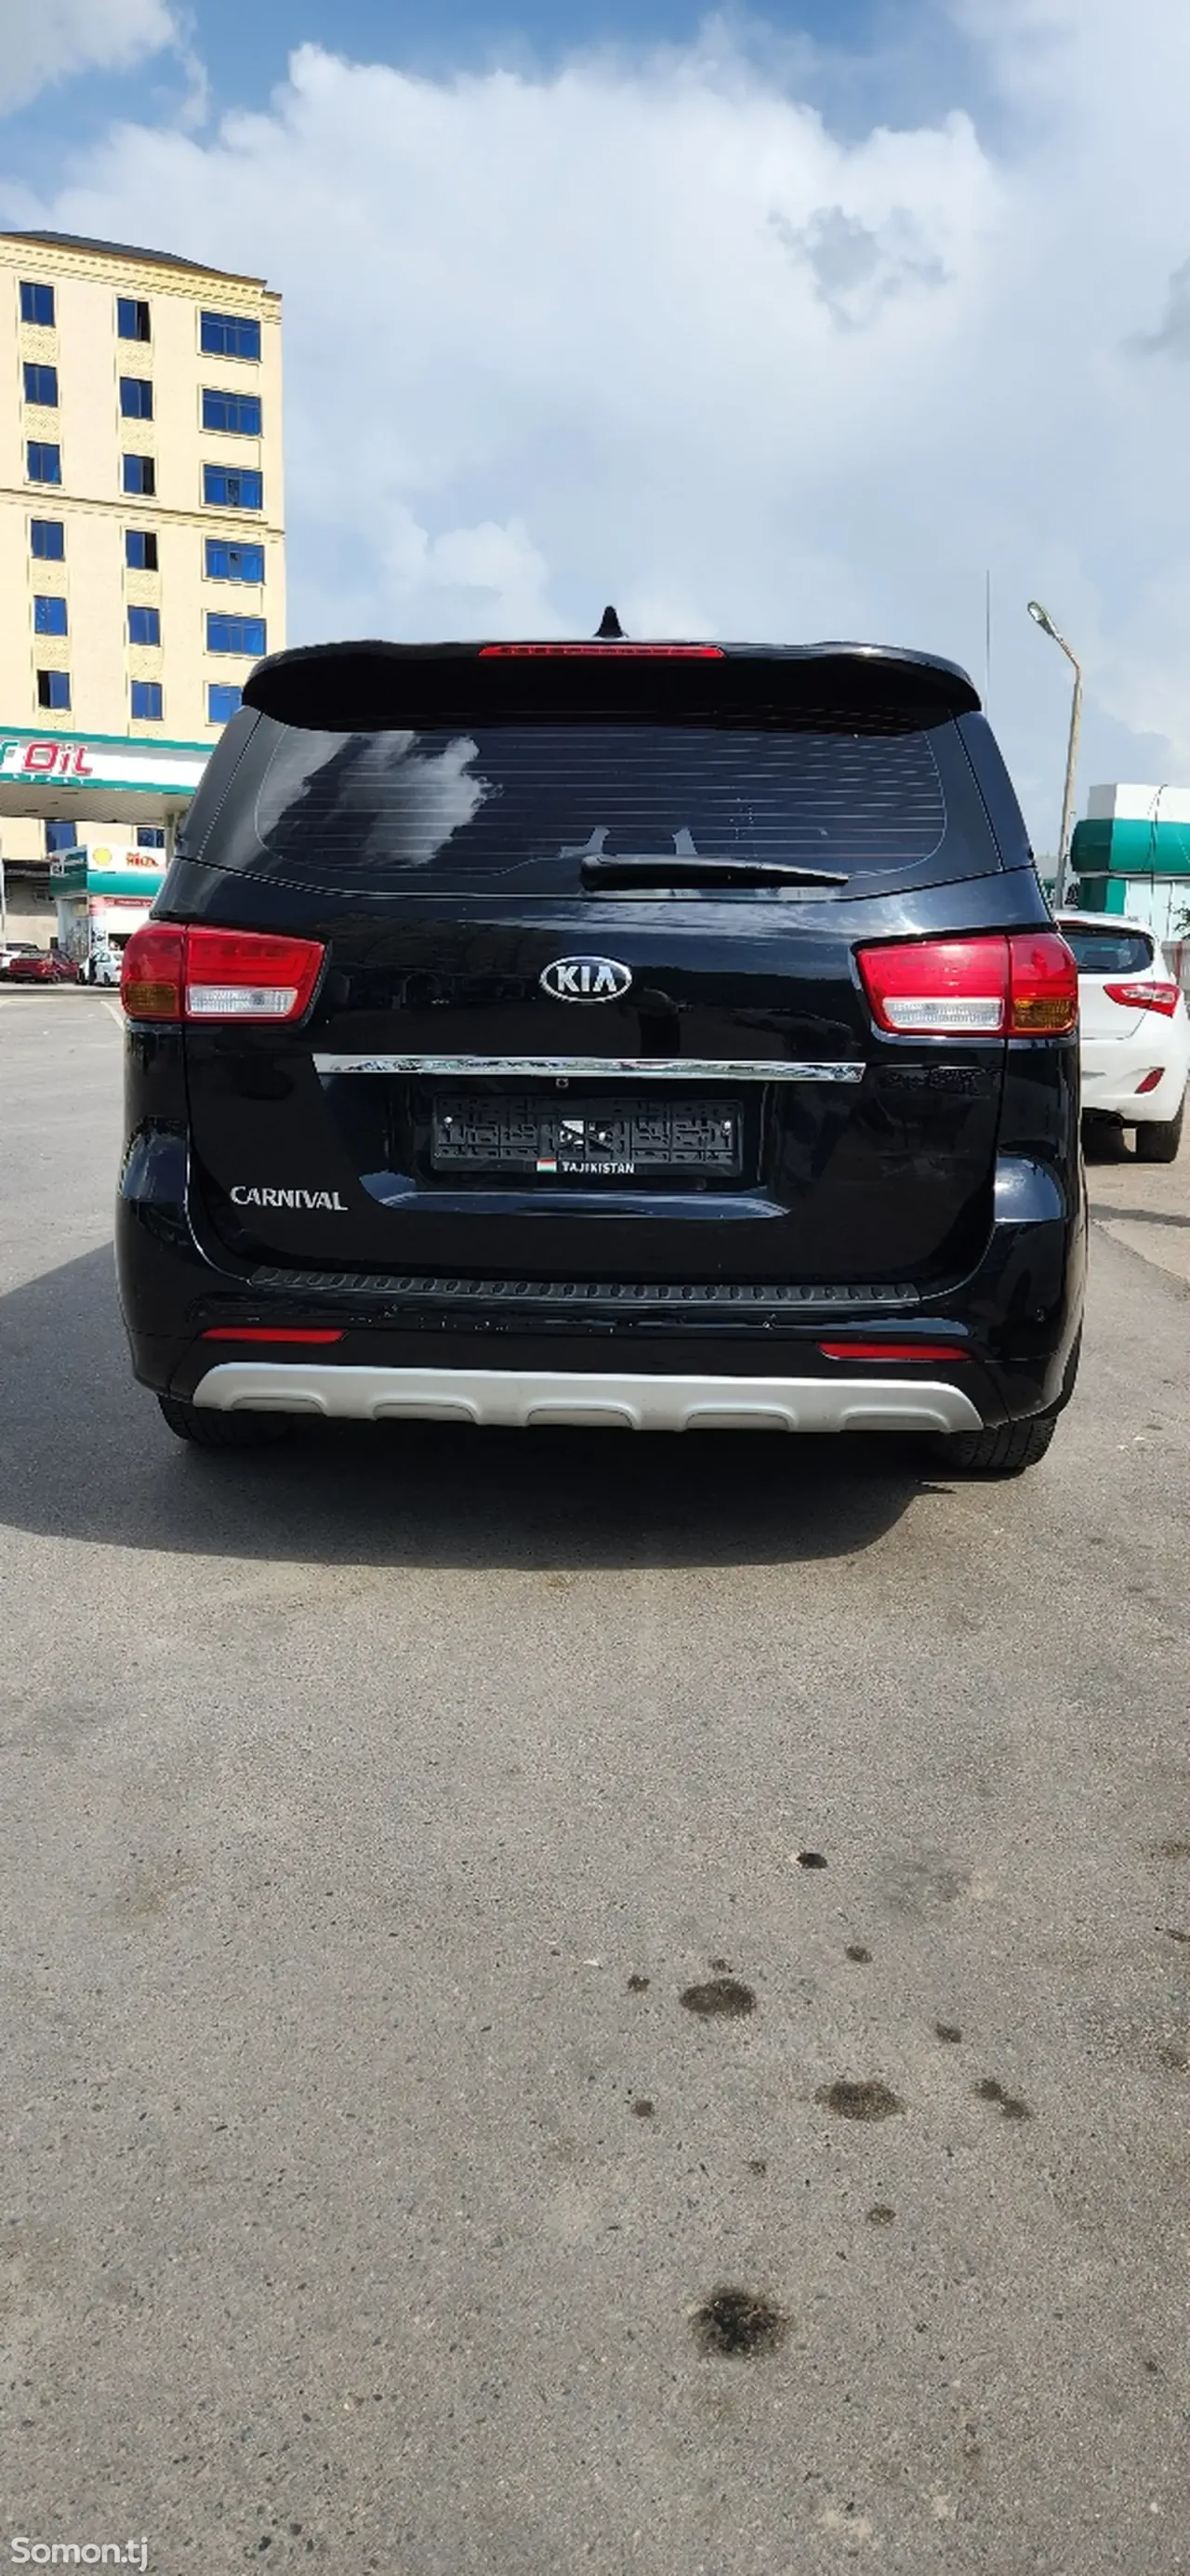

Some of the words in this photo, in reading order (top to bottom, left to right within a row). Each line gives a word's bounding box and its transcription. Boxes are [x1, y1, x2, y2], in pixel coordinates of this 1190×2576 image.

[556, 965, 617, 992] KIA
[562, 1161, 635, 1174] TAJIKISTAN
[230, 1186, 349, 1211] CARNIVAL
